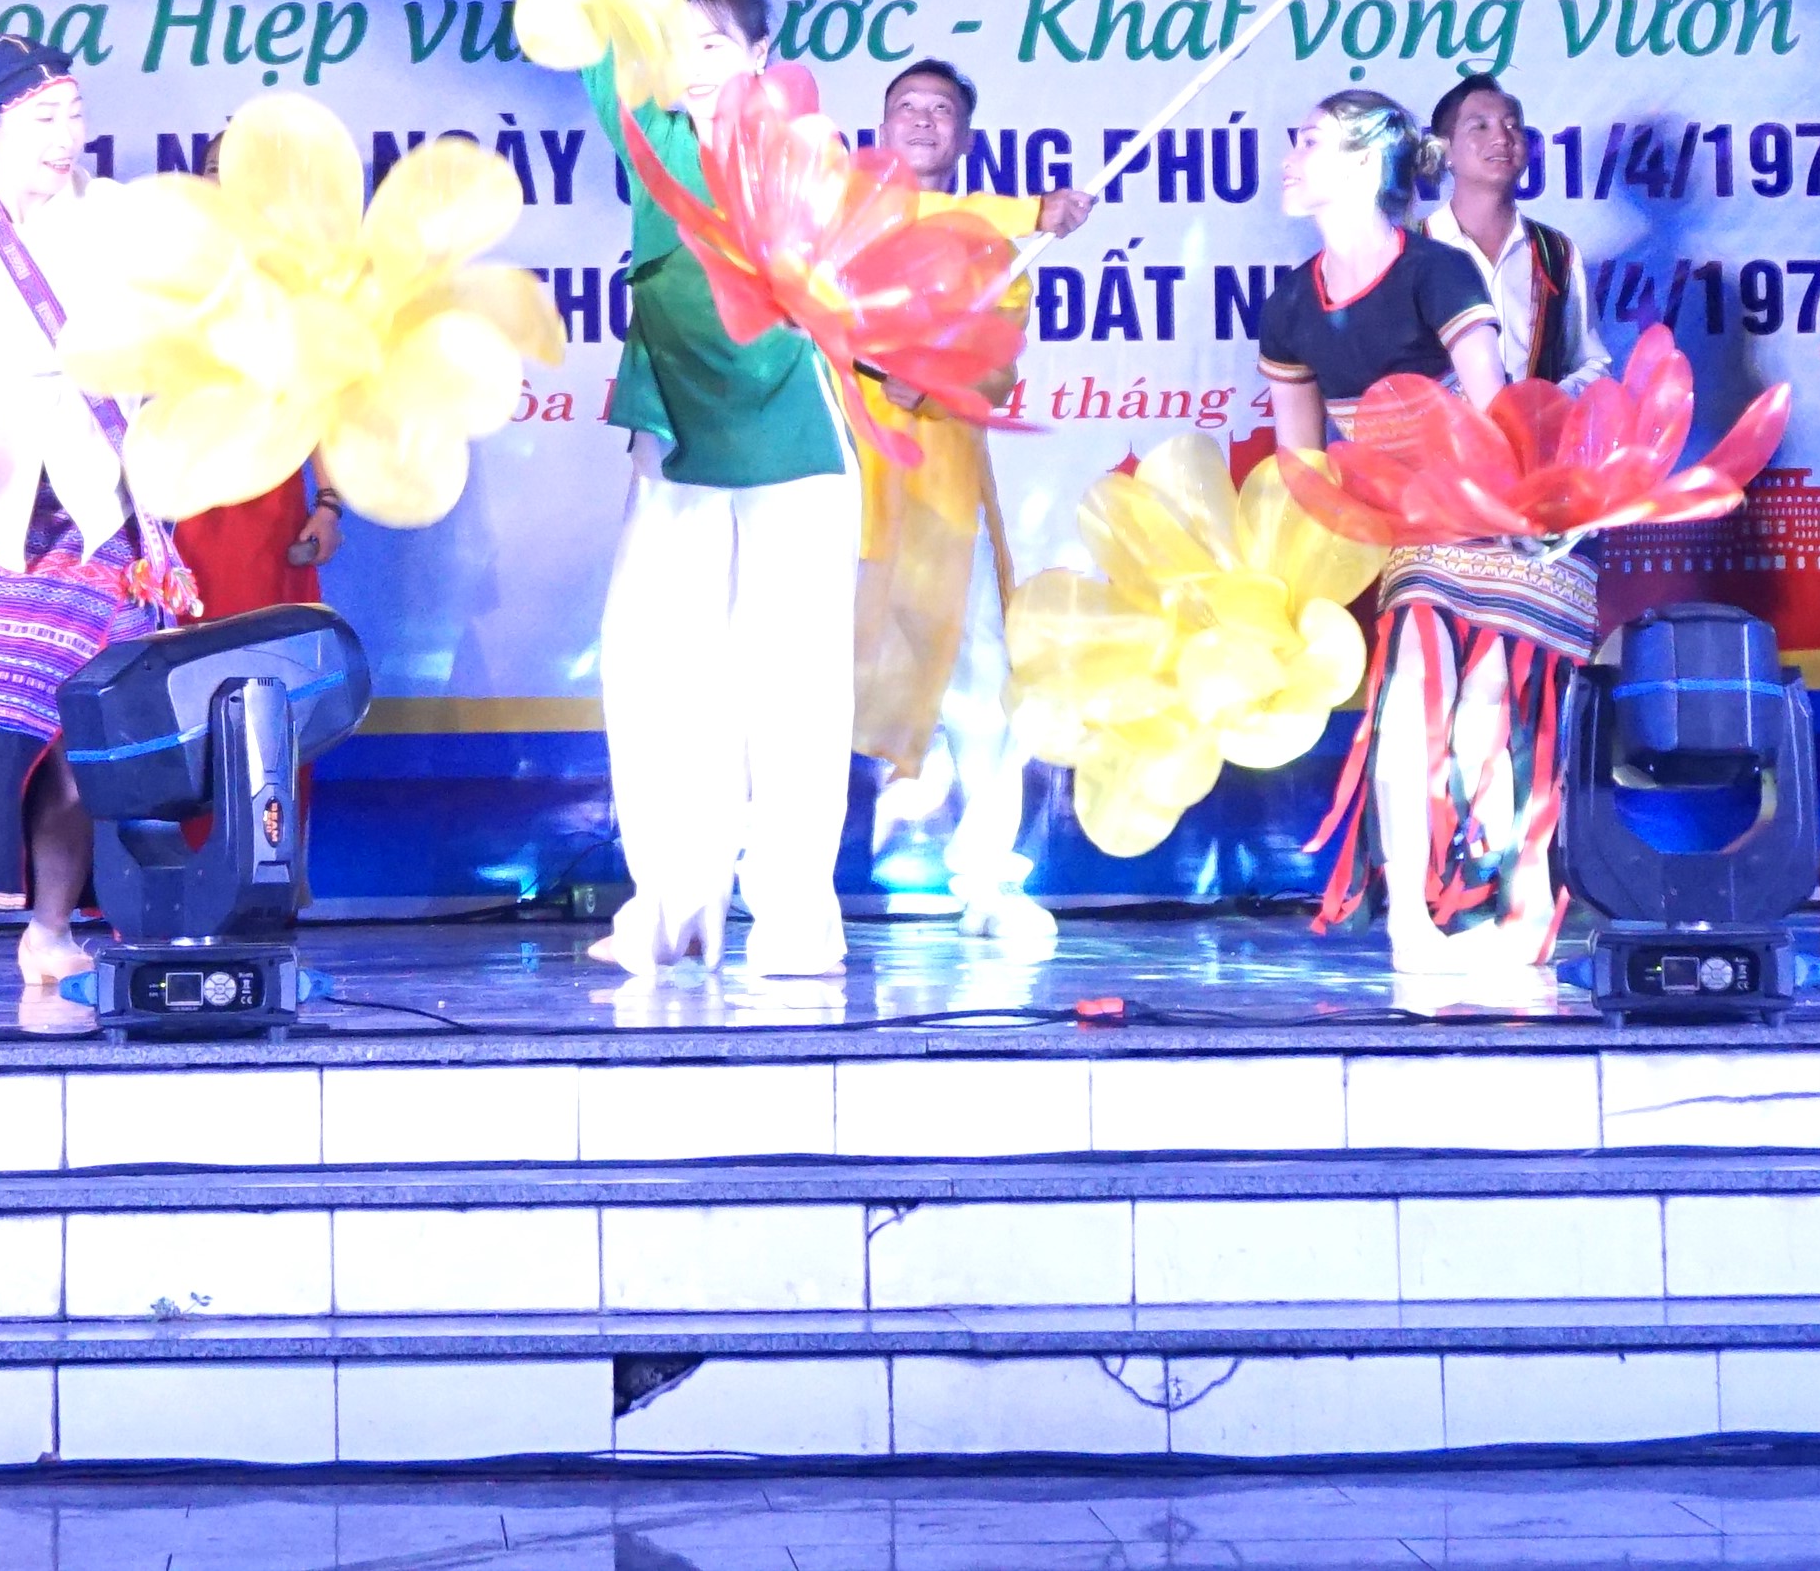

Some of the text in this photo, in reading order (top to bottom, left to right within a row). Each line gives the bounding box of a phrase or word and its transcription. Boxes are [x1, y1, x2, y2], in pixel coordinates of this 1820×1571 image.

[1103, 111, 1259, 203] PHÚ
[1035, 237, 1186, 341] ĐẤT
[1051, 376, 1236, 429] tháng
